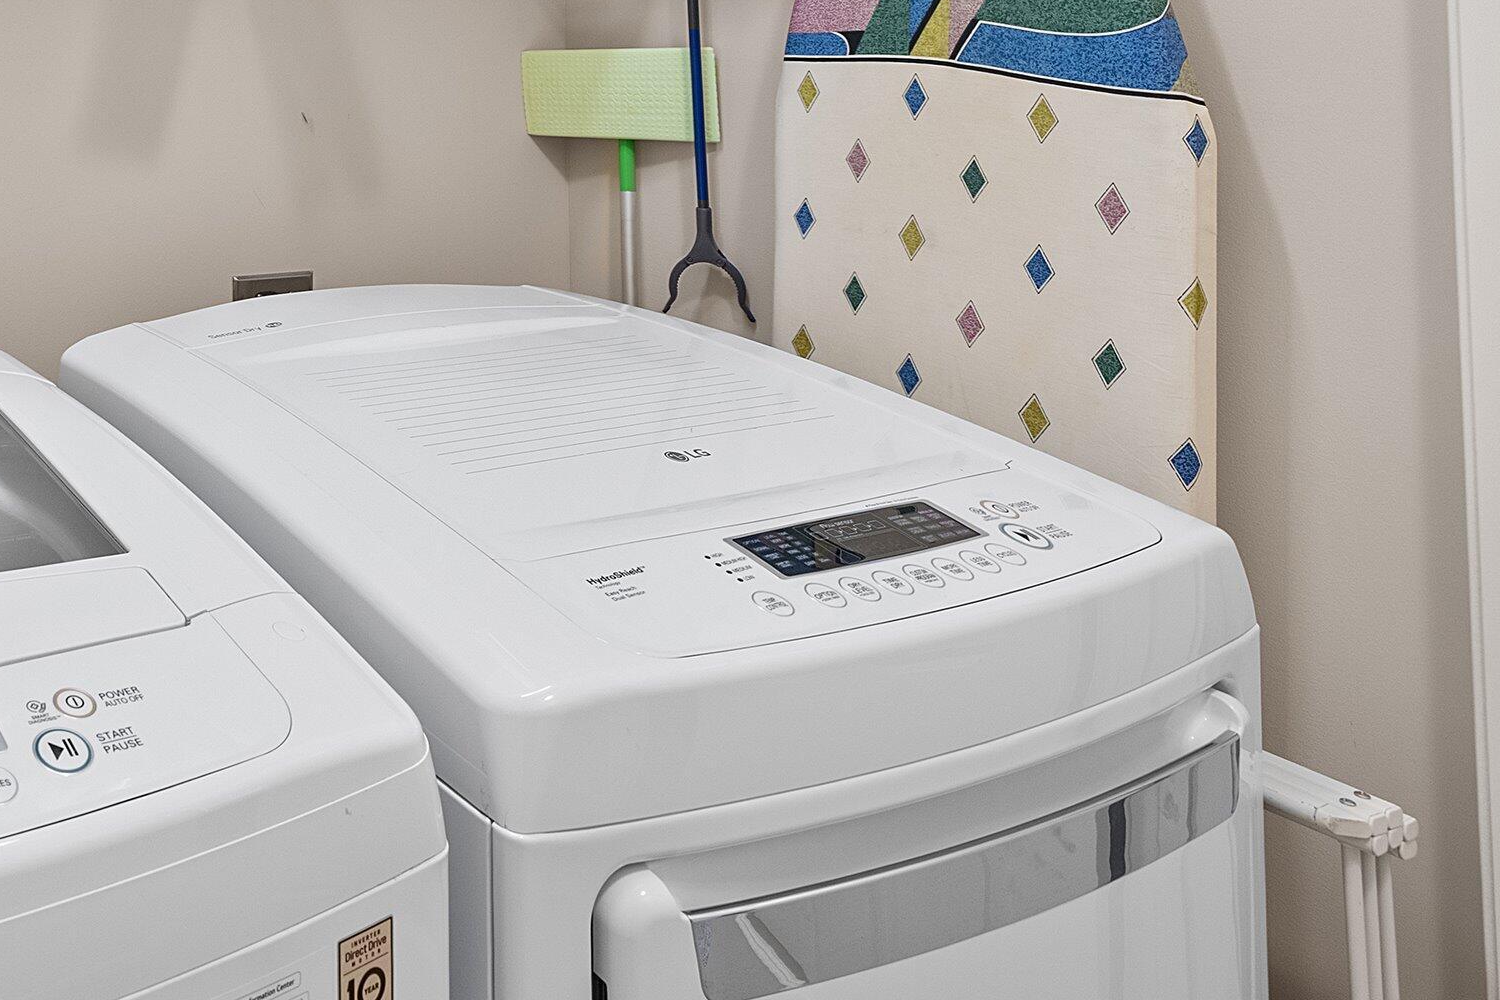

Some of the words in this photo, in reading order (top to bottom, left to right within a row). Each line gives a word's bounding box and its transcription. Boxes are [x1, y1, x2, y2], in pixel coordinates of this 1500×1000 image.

[683, 449, 711, 458] LG
[98, 686, 140, 701] POWER
[104, 697, 129, 708] AUTO
[129, 693, 145, 703] OFF
[96, 726, 135, 742] START
[103, 738, 144, 754] PAUSE
[351, 929, 381, 949] INVERTER
[345, 945, 367, 963] Direct
[368, 935, 387, 952] Drive
[351, 948, 381, 967] MOTOR
[276, 979, 295, 993] Center
[364, 982, 380, 995] YEAR
